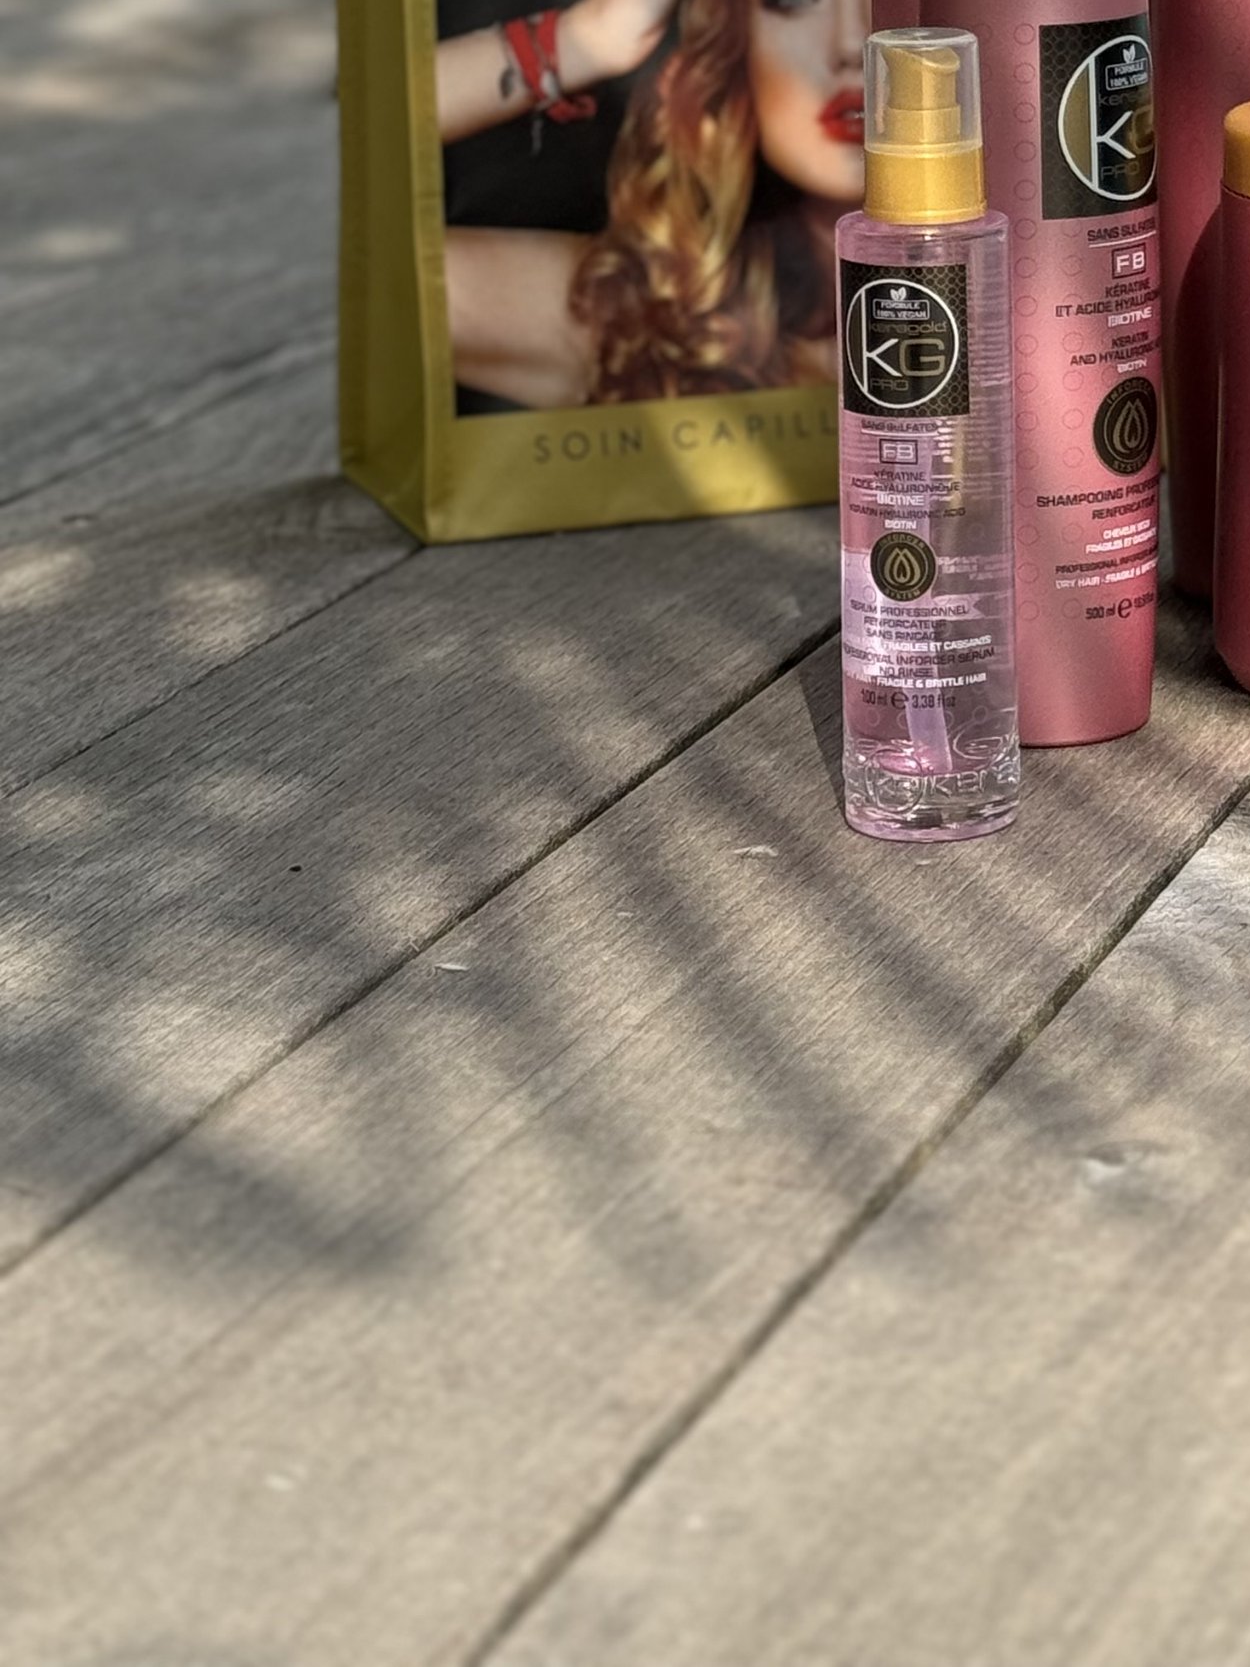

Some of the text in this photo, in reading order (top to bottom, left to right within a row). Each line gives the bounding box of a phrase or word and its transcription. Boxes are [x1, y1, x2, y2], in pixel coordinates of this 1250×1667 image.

[1087, 227, 1120, 242] SANS
[1117, 251, 1145, 273] FB
[1070, 353, 1097, 366] AND
[533, 424, 641, 463] SOIN
[883, 444, 914, 460] FB
[1036, 488, 1124, 507] SHAMPOOING
[880, 603, 970, 618] PROFESSIONNEL
